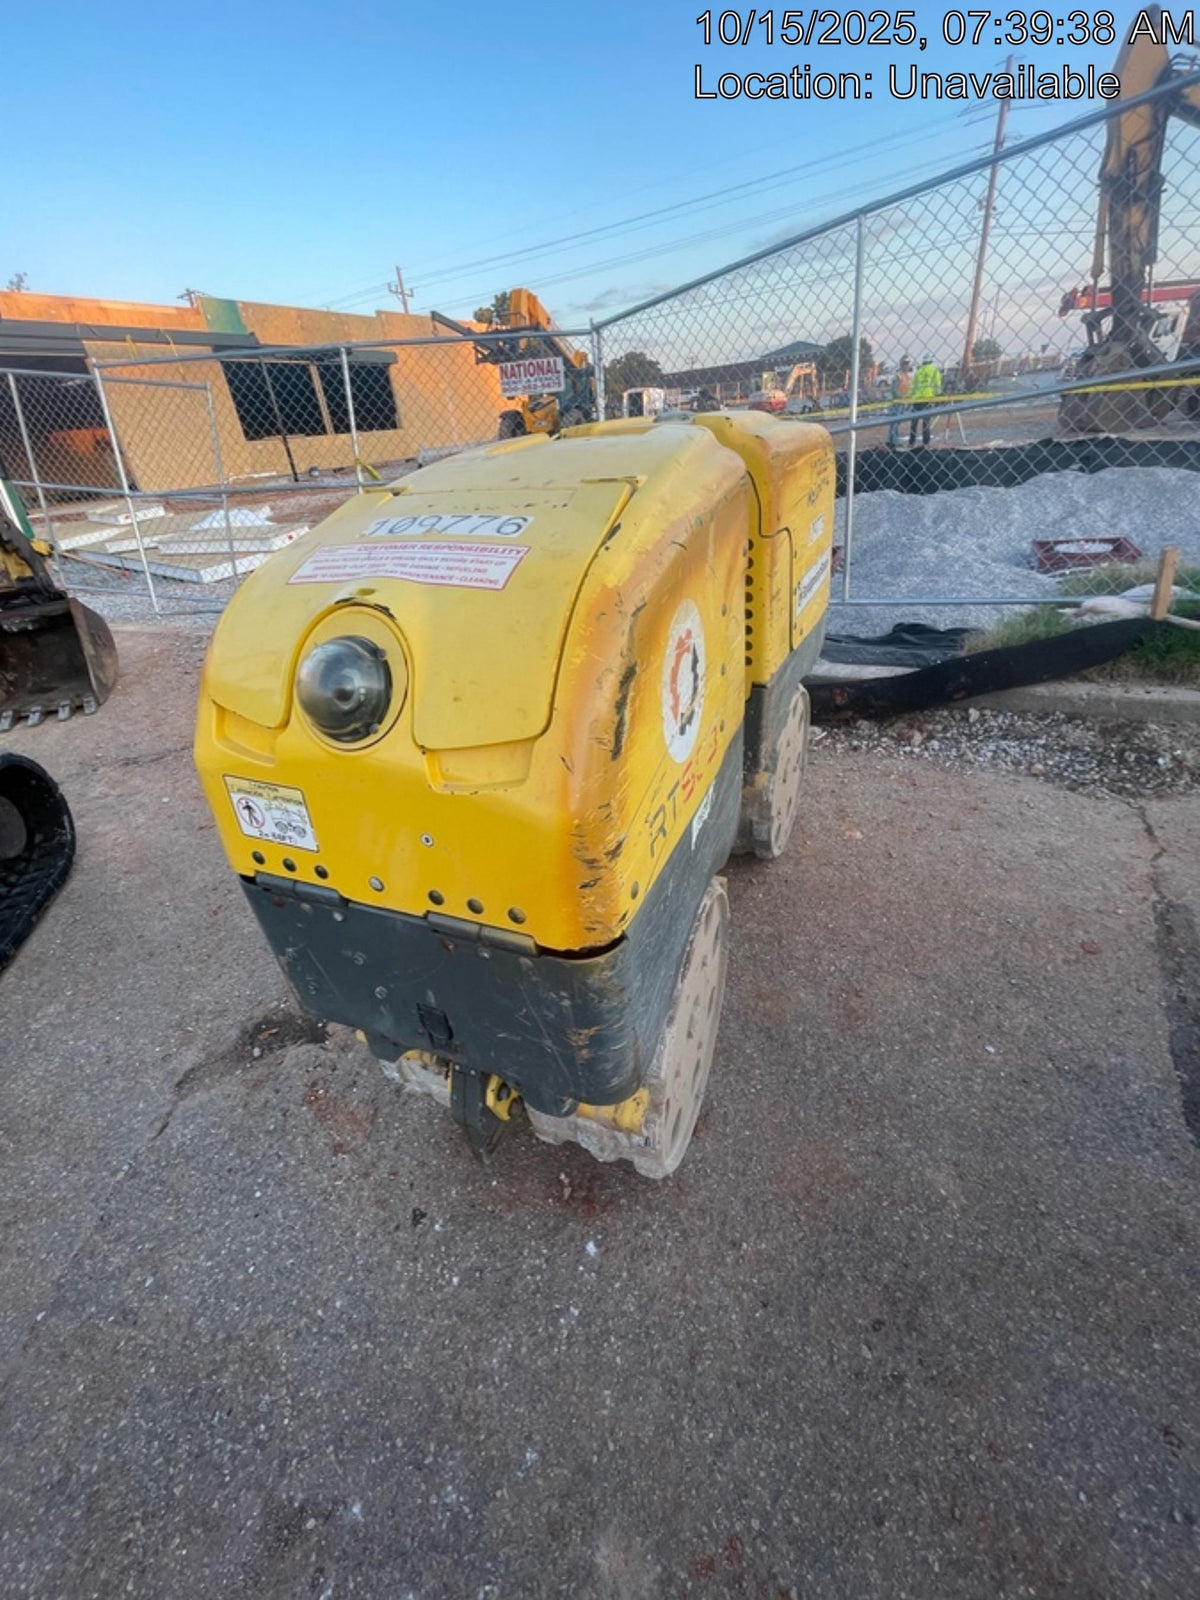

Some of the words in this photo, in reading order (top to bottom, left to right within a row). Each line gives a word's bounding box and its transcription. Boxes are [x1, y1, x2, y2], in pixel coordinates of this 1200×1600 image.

[499, 359, 561, 380] NATIONAL
[368, 515, 529, 536] 109776
[418, 543, 525, 555] RESPONSIBILITY
